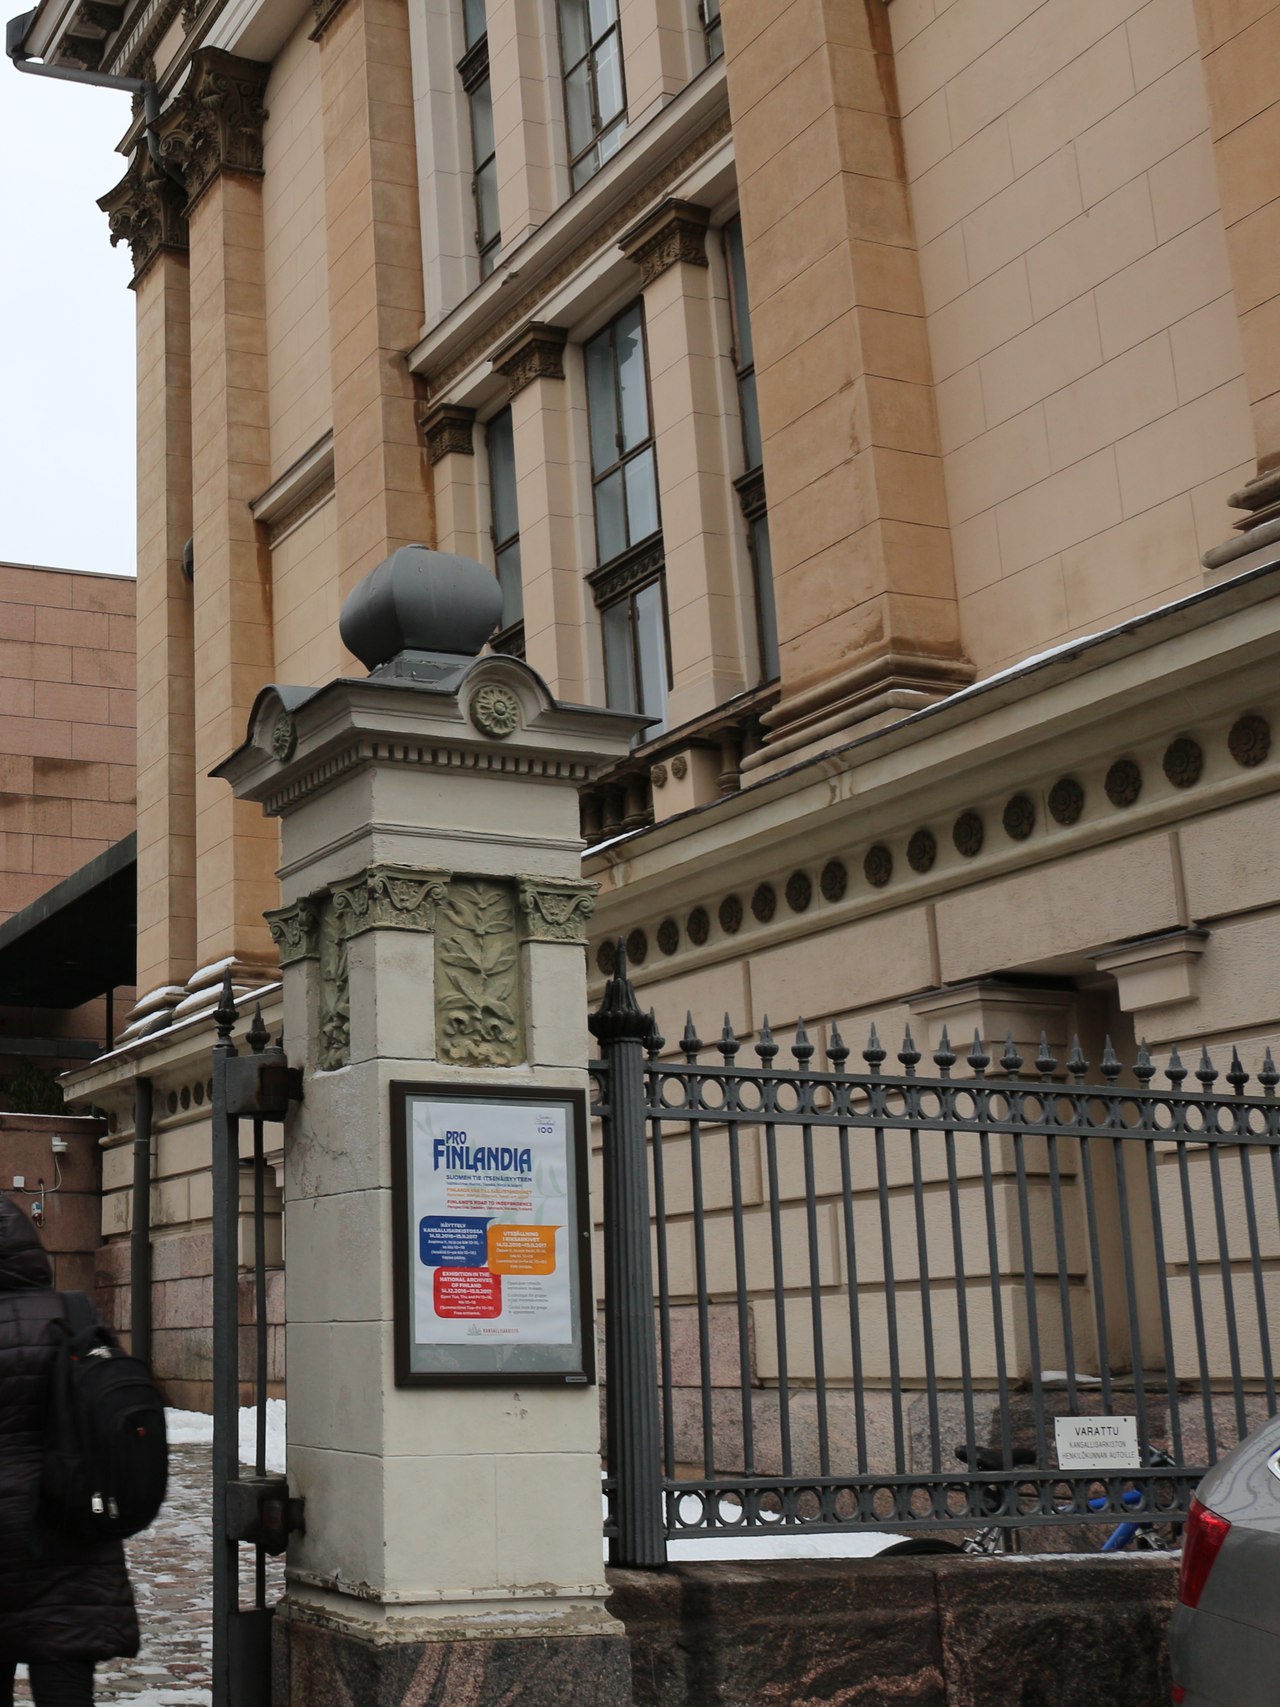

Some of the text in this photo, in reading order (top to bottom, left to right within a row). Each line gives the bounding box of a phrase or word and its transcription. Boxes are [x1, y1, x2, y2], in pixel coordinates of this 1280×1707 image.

[538, 1126, 553, 1134] 100
[446, 1131, 467, 1145] PRO
[433, 1138, 532, 1174] FINLANDIA
[1074, 1426, 1119, 1436] VARATTU
[1110, 1451, 1135, 1459] AUTOILLE
